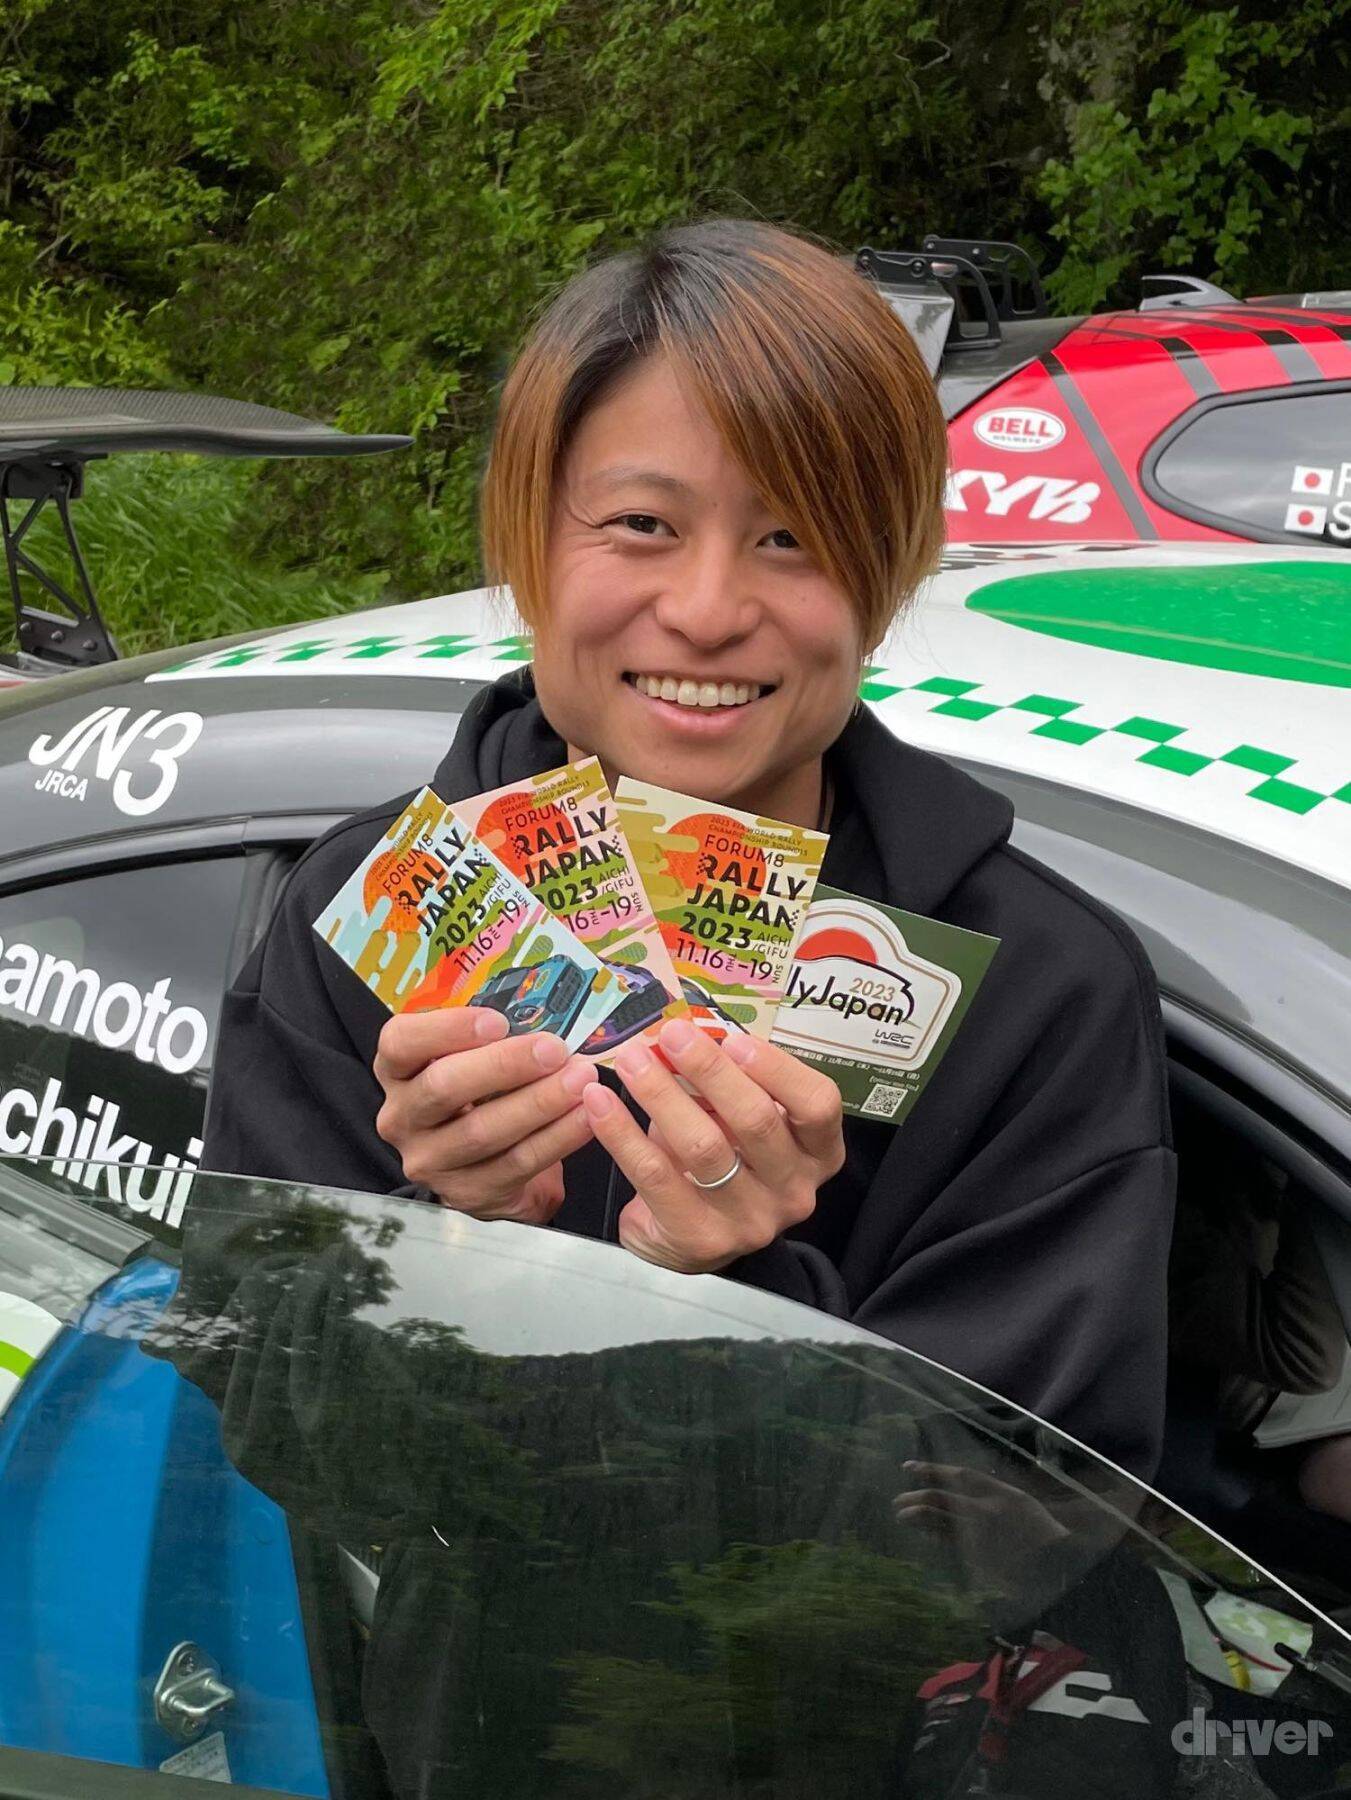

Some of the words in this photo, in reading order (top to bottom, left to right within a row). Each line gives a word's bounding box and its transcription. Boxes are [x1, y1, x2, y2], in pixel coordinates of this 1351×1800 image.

[988, 416, 1055, 438] BELL
[29, 706, 203, 816] JN3
[35, 769, 89, 802] JRCA
[505, 797, 577, 831] FORUM8
[510, 807, 607, 859] RALLY
[382, 833, 433, 894] FORUM8
[395, 827, 466, 914] RALLY
[525, 835, 624, 888] JAPAN
[596, 865, 631, 882] AICHI
[704, 834, 785, 868] FORUM8
[417, 848, 491, 936] JAPAN
[513, 890, 531, 909] SUN
[696, 852, 807, 901] RALLY
[435, 898, 487, 957] 2023
[479, 872, 503, 897] AICHI
[630, 892, 644, 913] SUN
[687, 883, 800, 932] JAPAN
[679, 911, 754, 949] 2023
[757, 932, 791, 947] AICHI
[772, 963, 784, 984] SUN
[785, 964, 904, 1026] lyJapan
[849, 976, 896, 1002] 2023
[0, 936, 207, 1074] amoto
[0, 1077, 205, 1229] chikui
